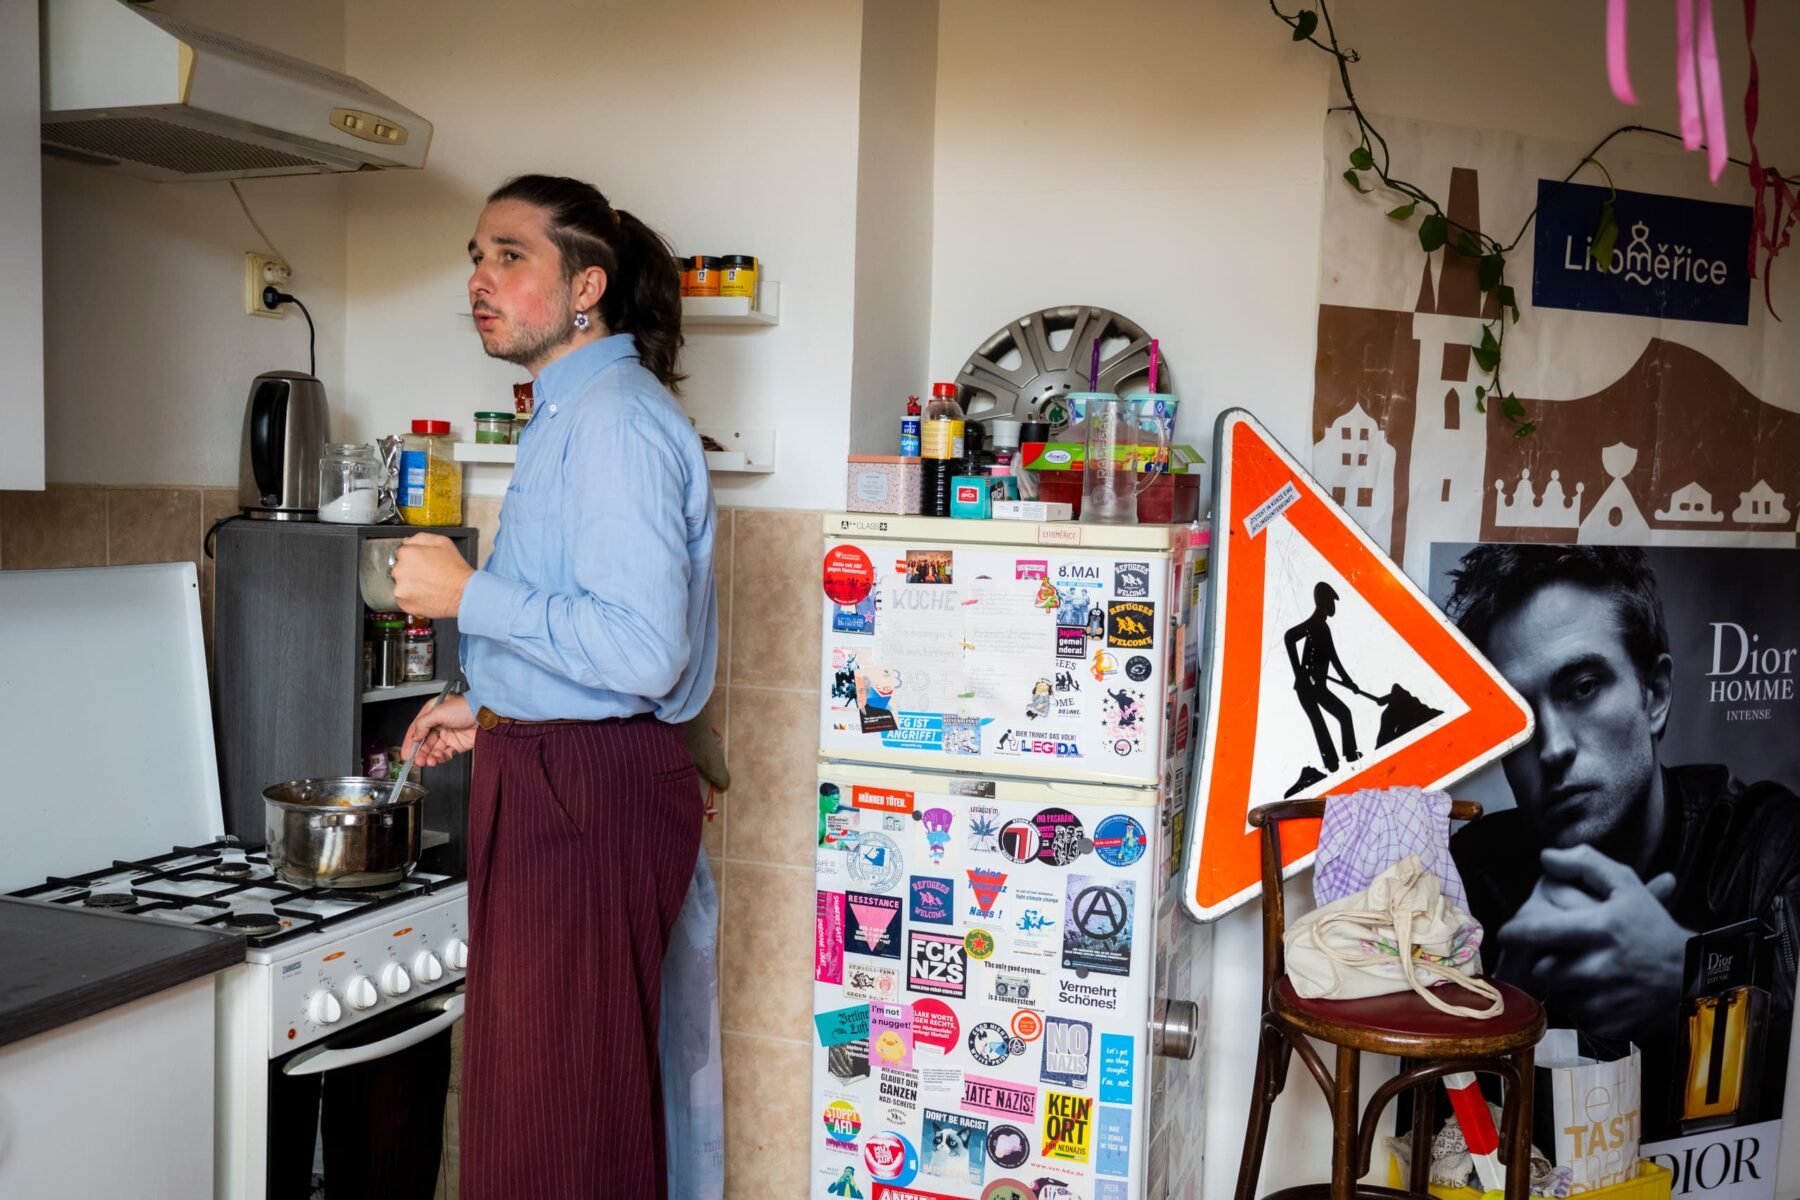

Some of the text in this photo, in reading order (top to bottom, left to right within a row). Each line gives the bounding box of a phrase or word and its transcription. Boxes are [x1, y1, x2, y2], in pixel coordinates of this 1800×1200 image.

[1564, 221, 1728, 286] Lioměřice
[1114, 563, 1150, 575] REFUGEES
[1116, 587, 1147, 597] WELCOME
[1108, 603, 1154, 616] REFUGEES
[1108, 634, 1153, 648] WELCOME
[1058, 646, 1083, 655] nderat
[1705, 622, 1798, 676] Dior
[1709, 679, 1794, 702] HOMME
[1726, 709, 1772, 721] INTENSE
[912, 718, 929, 729] IST
[886, 730, 937, 742] ANGRIFF!
[1028, 731, 1048, 739] TRINKT
[1049, 732, 1060, 740] DAS
[1021, 739, 1079, 755] LEGIDA
[858, 793, 907, 808] MÄNNER TÖTEN.
[911, 880, 950, 894] REFUGEES
[847, 894, 900, 909] RESISTANCE
[914, 906, 948, 920] WELCOME
[911, 938, 965, 966] FCK
[984, 960, 994, 969] The
[1707, 951, 1735, 970] Dior
[910, 958, 965, 985] NZS
[1059, 979, 1118, 999] Vermehrt
[1058, 992, 1117, 1010] Schönes!
[871, 1005, 900, 1017] I'm not
[930, 1012, 954, 1022] WORTE
[878, 1018, 912, 1031] nugget!
[1046, 1022, 1089, 1056] NO
[1046, 1053, 1088, 1076] NAZIS
[880, 1073, 905, 1086] GLAUBT
[905, 1078, 919, 1089] DEN
[879, 1082, 918, 1102] GANZEN
[998, 1090, 1036, 1114] NAZIS!
[1047, 1093, 1090, 1121] KEIN
[824, 1107, 858, 1123] STOPPT
[925, 1110, 987, 1131] DON'T BE RACIST
[833, 1120, 853, 1135] AFD
[1046, 1116, 1089, 1146] ORT
[1057, 1144, 1086, 1156] NEONAZIS
[1646, 1137, 1762, 1196] DIOR
